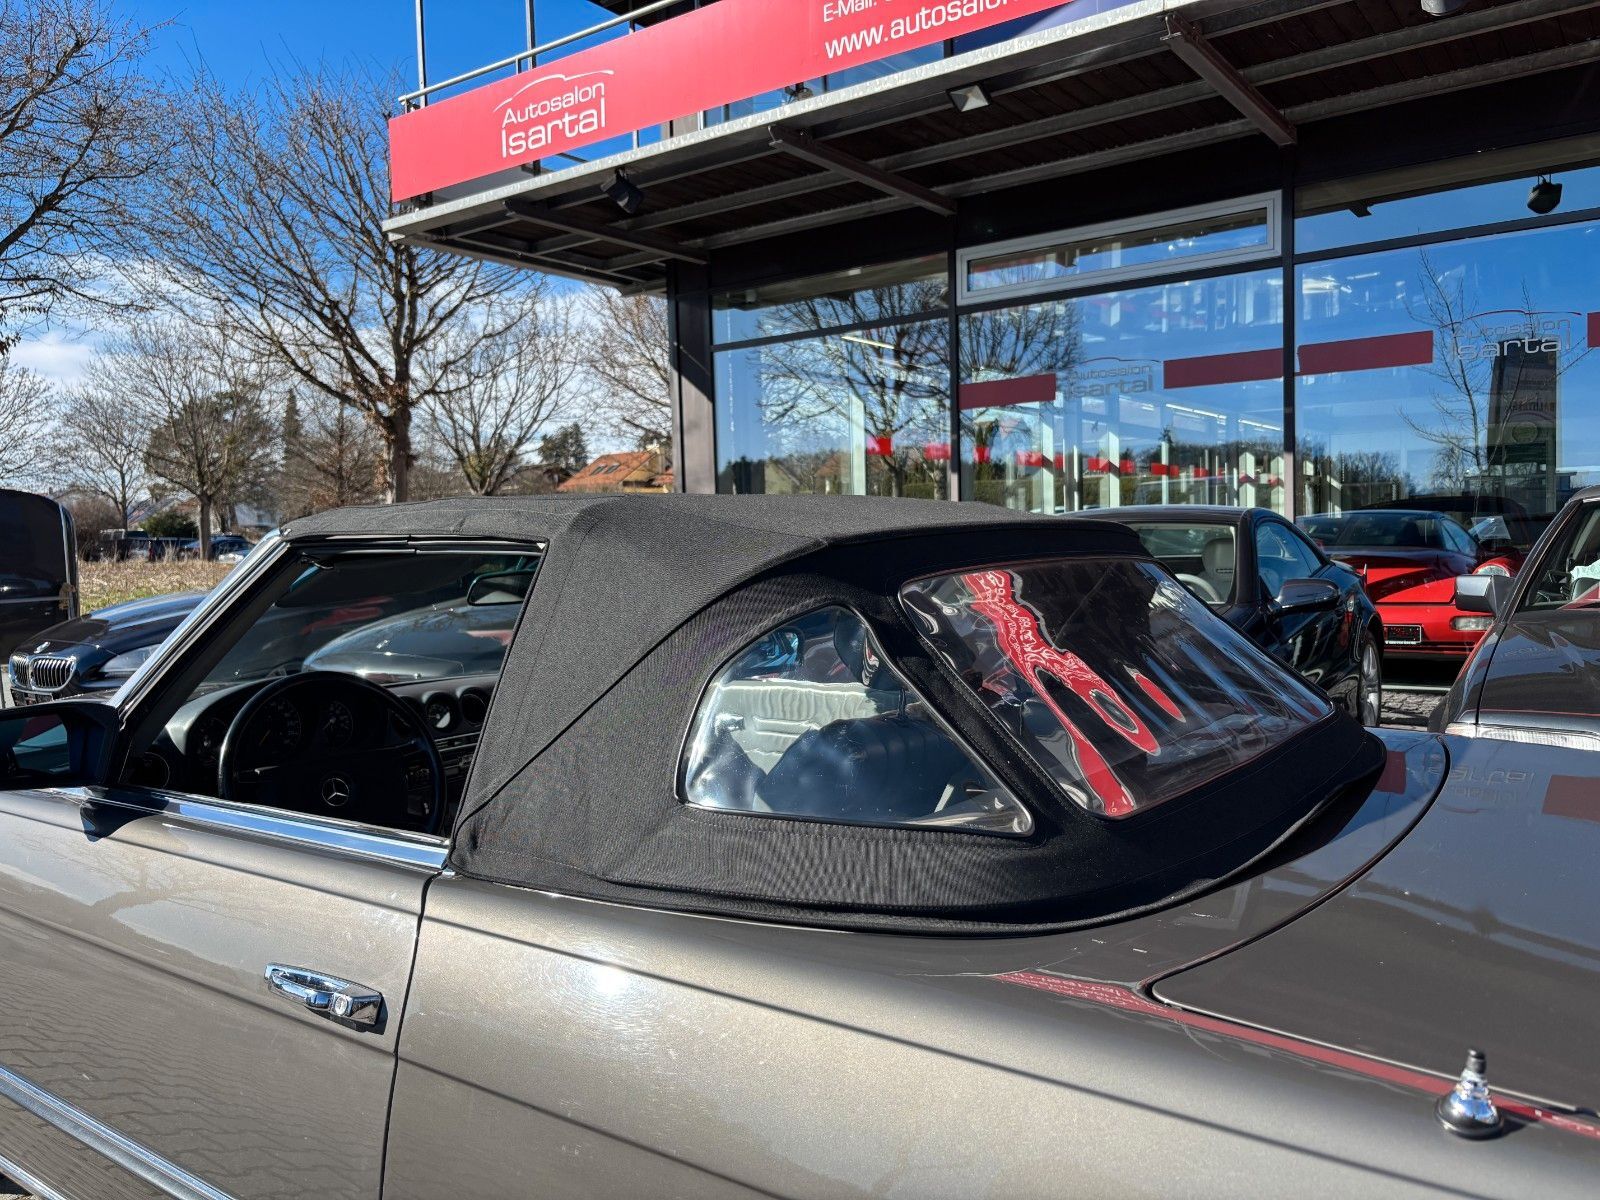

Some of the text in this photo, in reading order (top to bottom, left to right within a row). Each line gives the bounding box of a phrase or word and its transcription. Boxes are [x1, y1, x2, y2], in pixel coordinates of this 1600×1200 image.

[825, 0, 1008, 59] www.autosalo
[502, 82, 605, 128] Autosalon
[502, 97, 606, 158] Isartal
[1452, 318, 1571, 339] Autosalon
